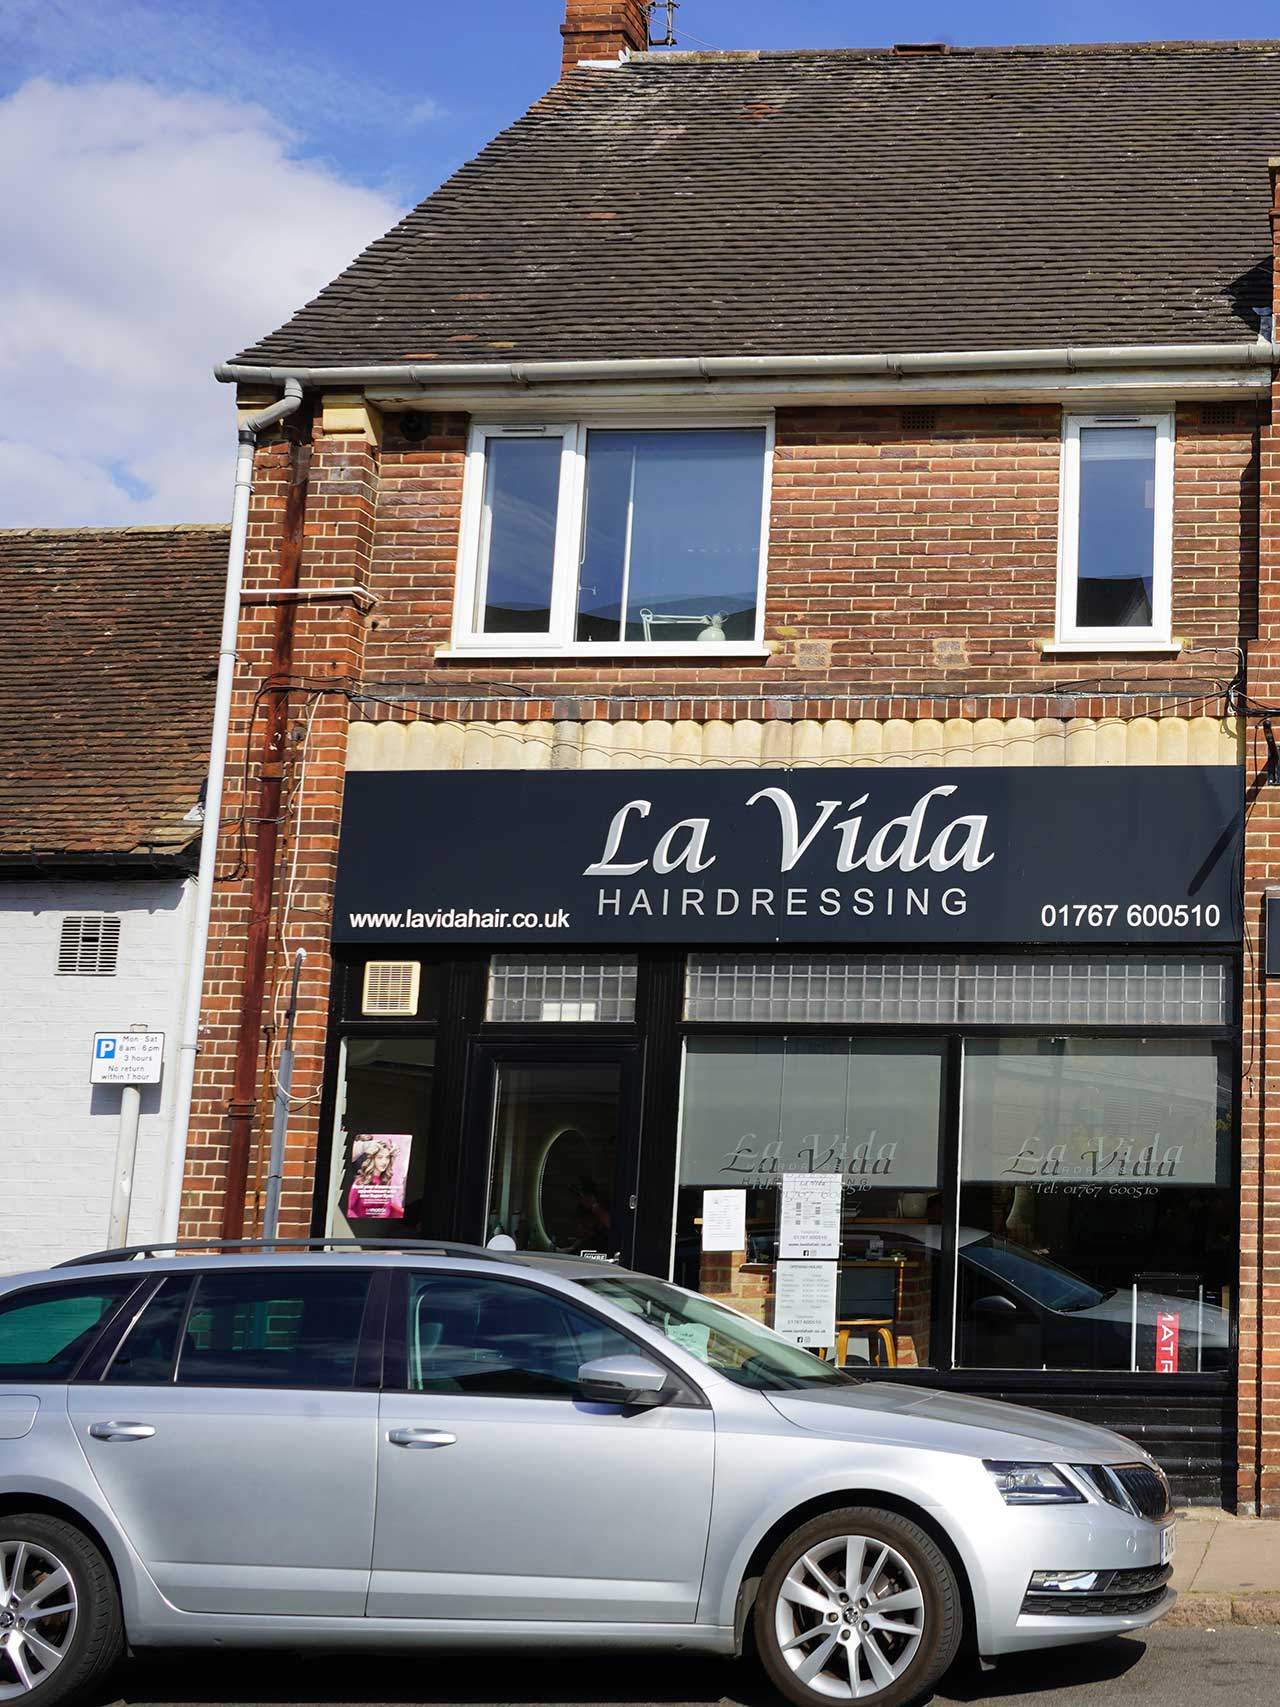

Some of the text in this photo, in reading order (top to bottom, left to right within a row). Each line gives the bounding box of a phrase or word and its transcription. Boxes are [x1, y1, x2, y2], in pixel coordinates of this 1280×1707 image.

[582, 784, 995, 876] La Vida
[598, 887, 968, 916] HAIRDRESSING
[349, 908, 570, 929] www.lavidahair.co.uk
[1040, 904, 1221, 927] 01767 600510
[99, 1040, 114, 1058] P
[798, 1130, 898, 1174] Vida
[1081, 1133, 1185, 1176] Vida
[1031, 1182, 1159, 1198] Tel: 01767 600510
